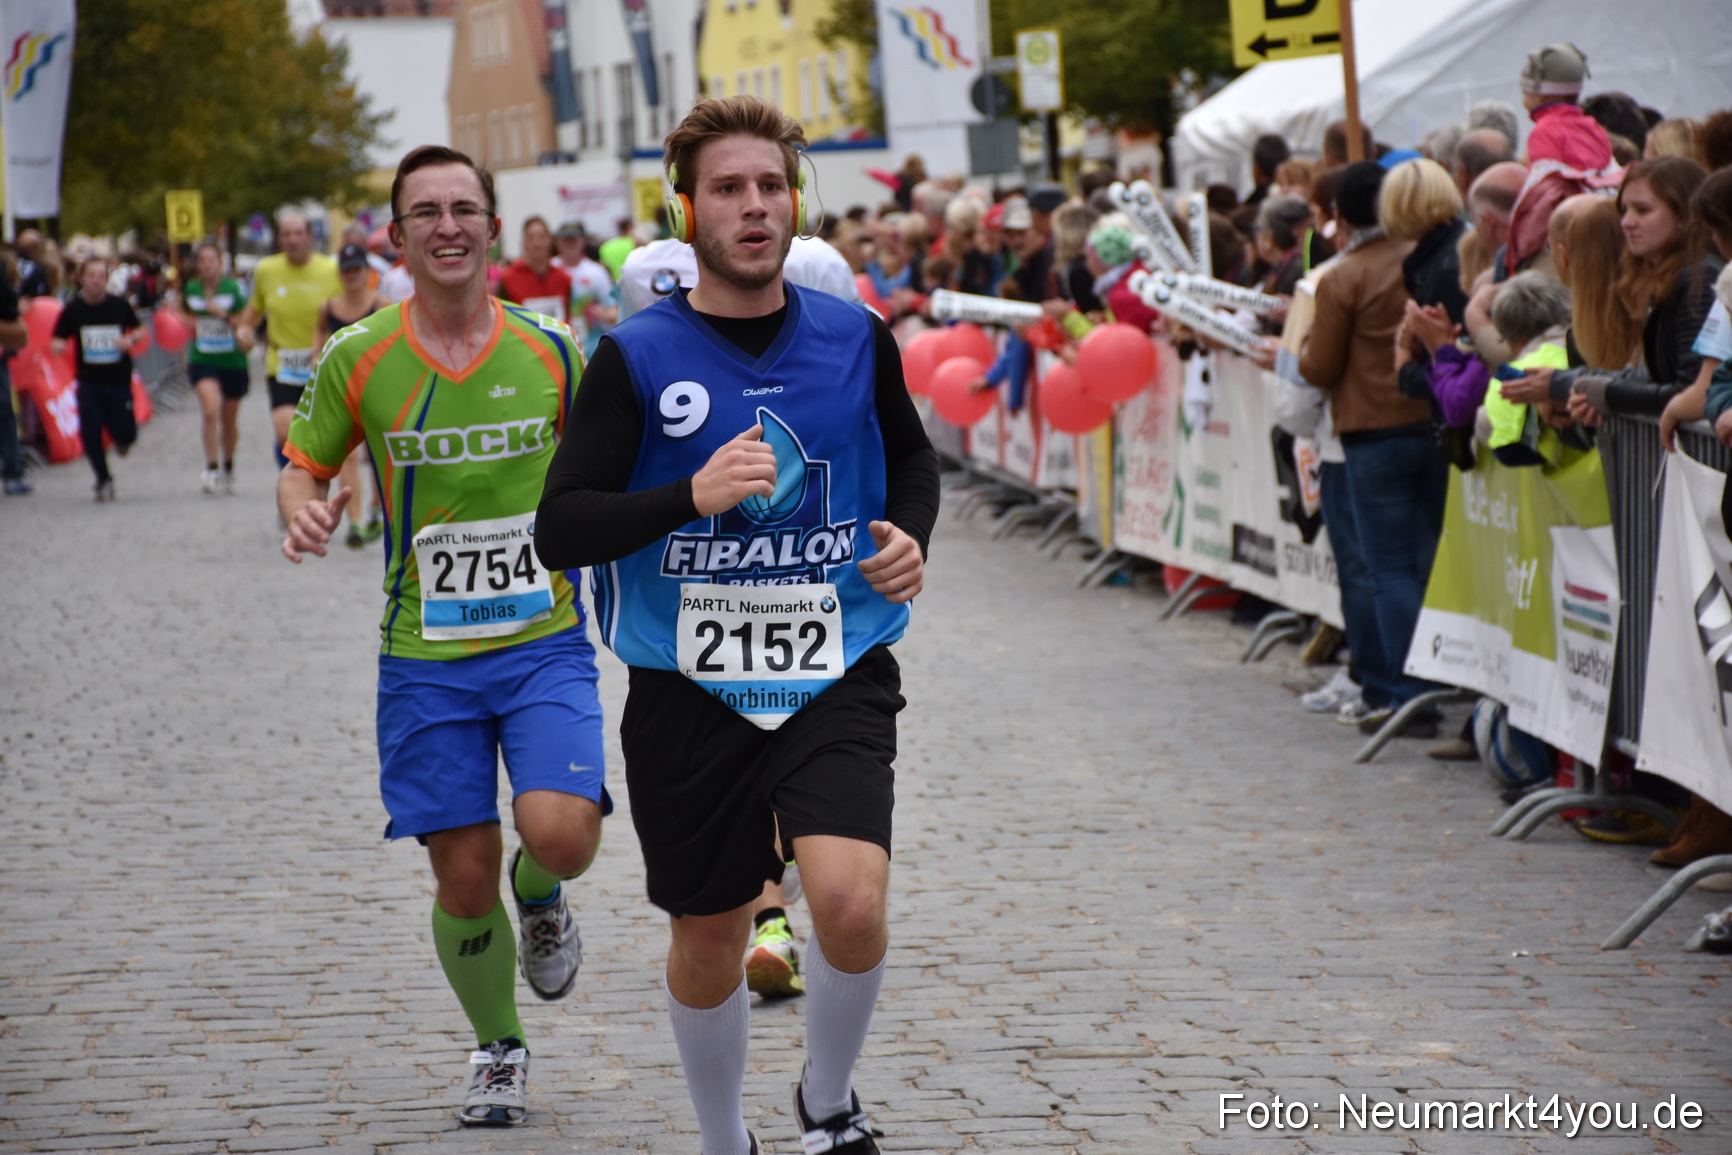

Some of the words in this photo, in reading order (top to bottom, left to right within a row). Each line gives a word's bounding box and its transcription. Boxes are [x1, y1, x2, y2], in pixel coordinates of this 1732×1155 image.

[659, 380, 711, 438] 9
[383, 417, 547, 467] BOCK
[416, 533, 459, 548] PARTL
[462, 528, 522, 544] Neumarkt
[665, 525, 856, 572] FIBALON
[432, 543, 537, 593] 2754
[459, 603, 517, 622] Tobias
[682, 598, 735, 613] PARTL
[739, 600, 814, 614] Neumarkt
[695, 620, 828, 672] 2152
[712, 687, 812, 709] Korbinian
